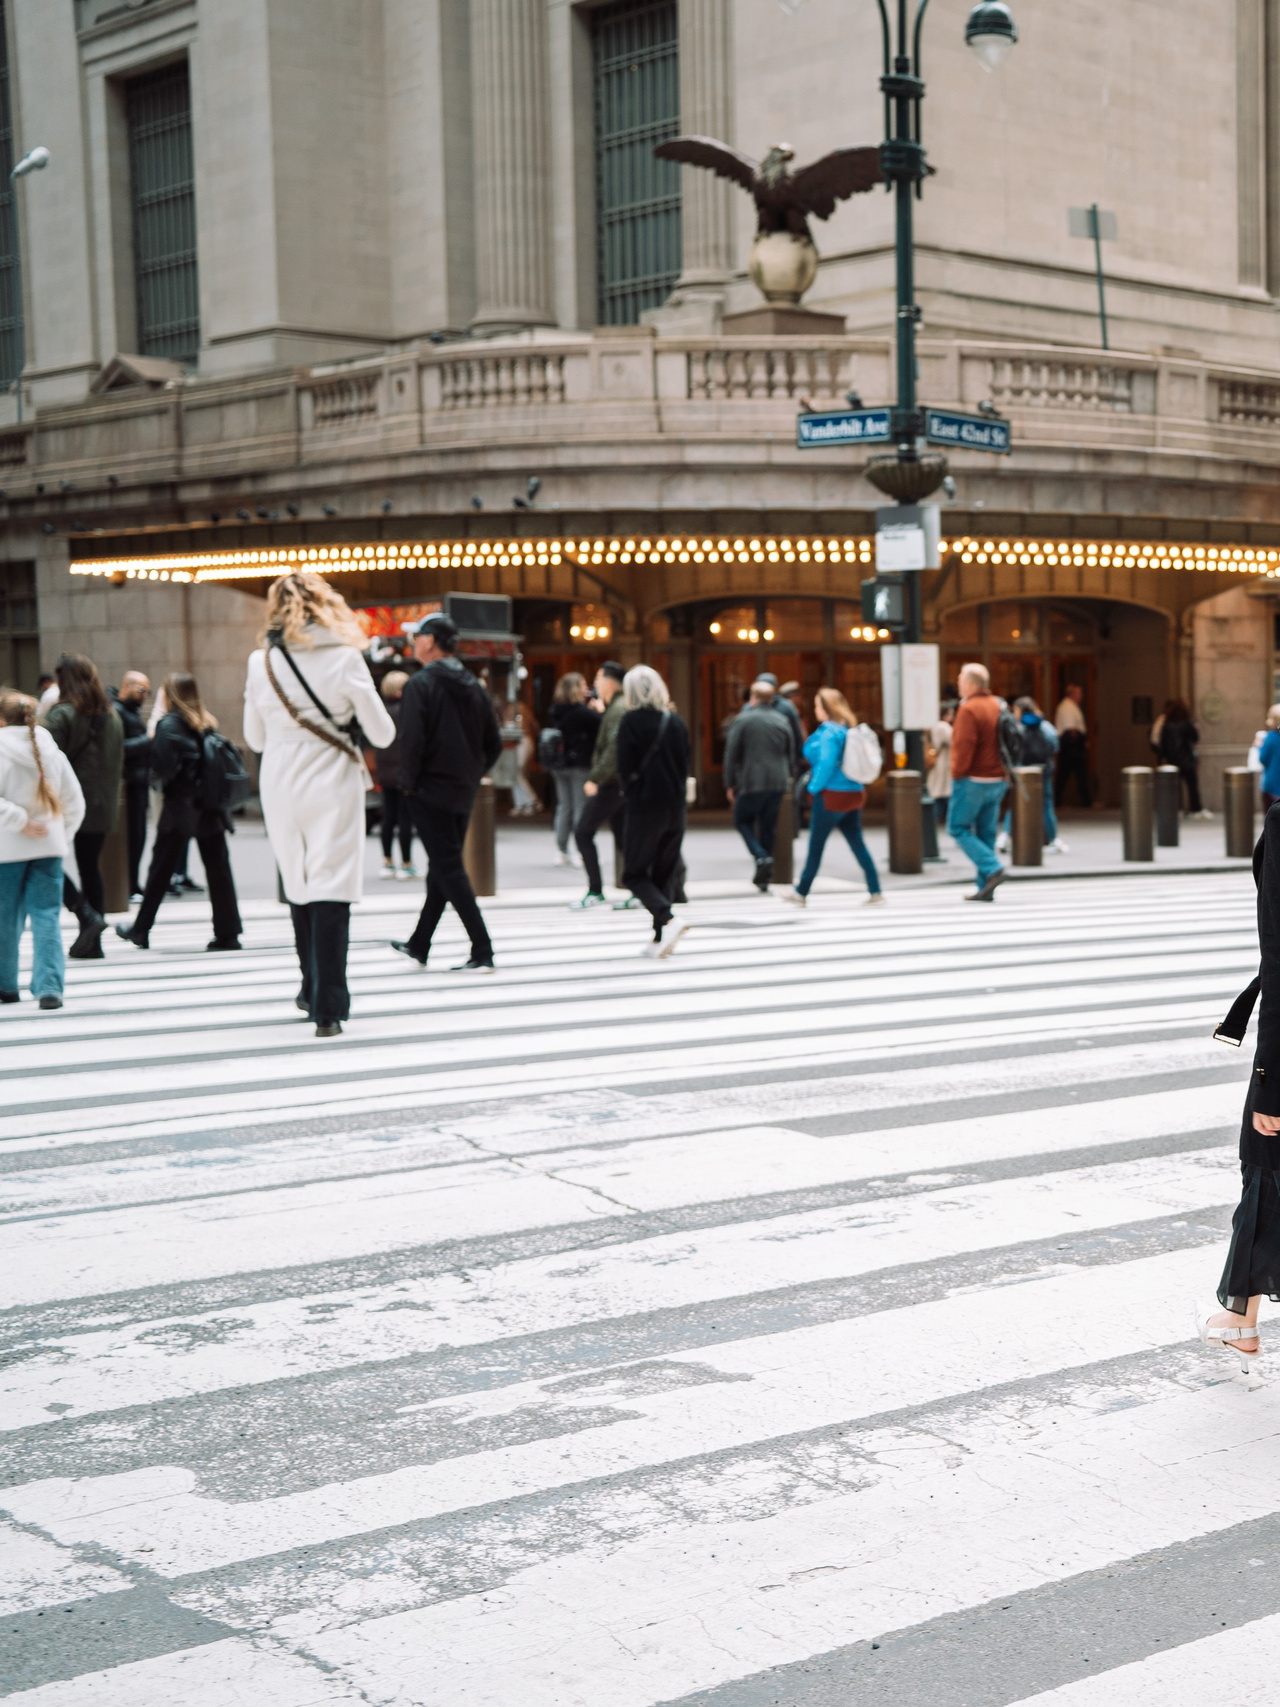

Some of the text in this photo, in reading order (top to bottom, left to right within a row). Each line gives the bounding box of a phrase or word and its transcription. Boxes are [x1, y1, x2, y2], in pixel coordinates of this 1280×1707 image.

[800, 417, 888, 439] Vanderbilt Ave
[931, 417, 1006, 446] East 42nd St
